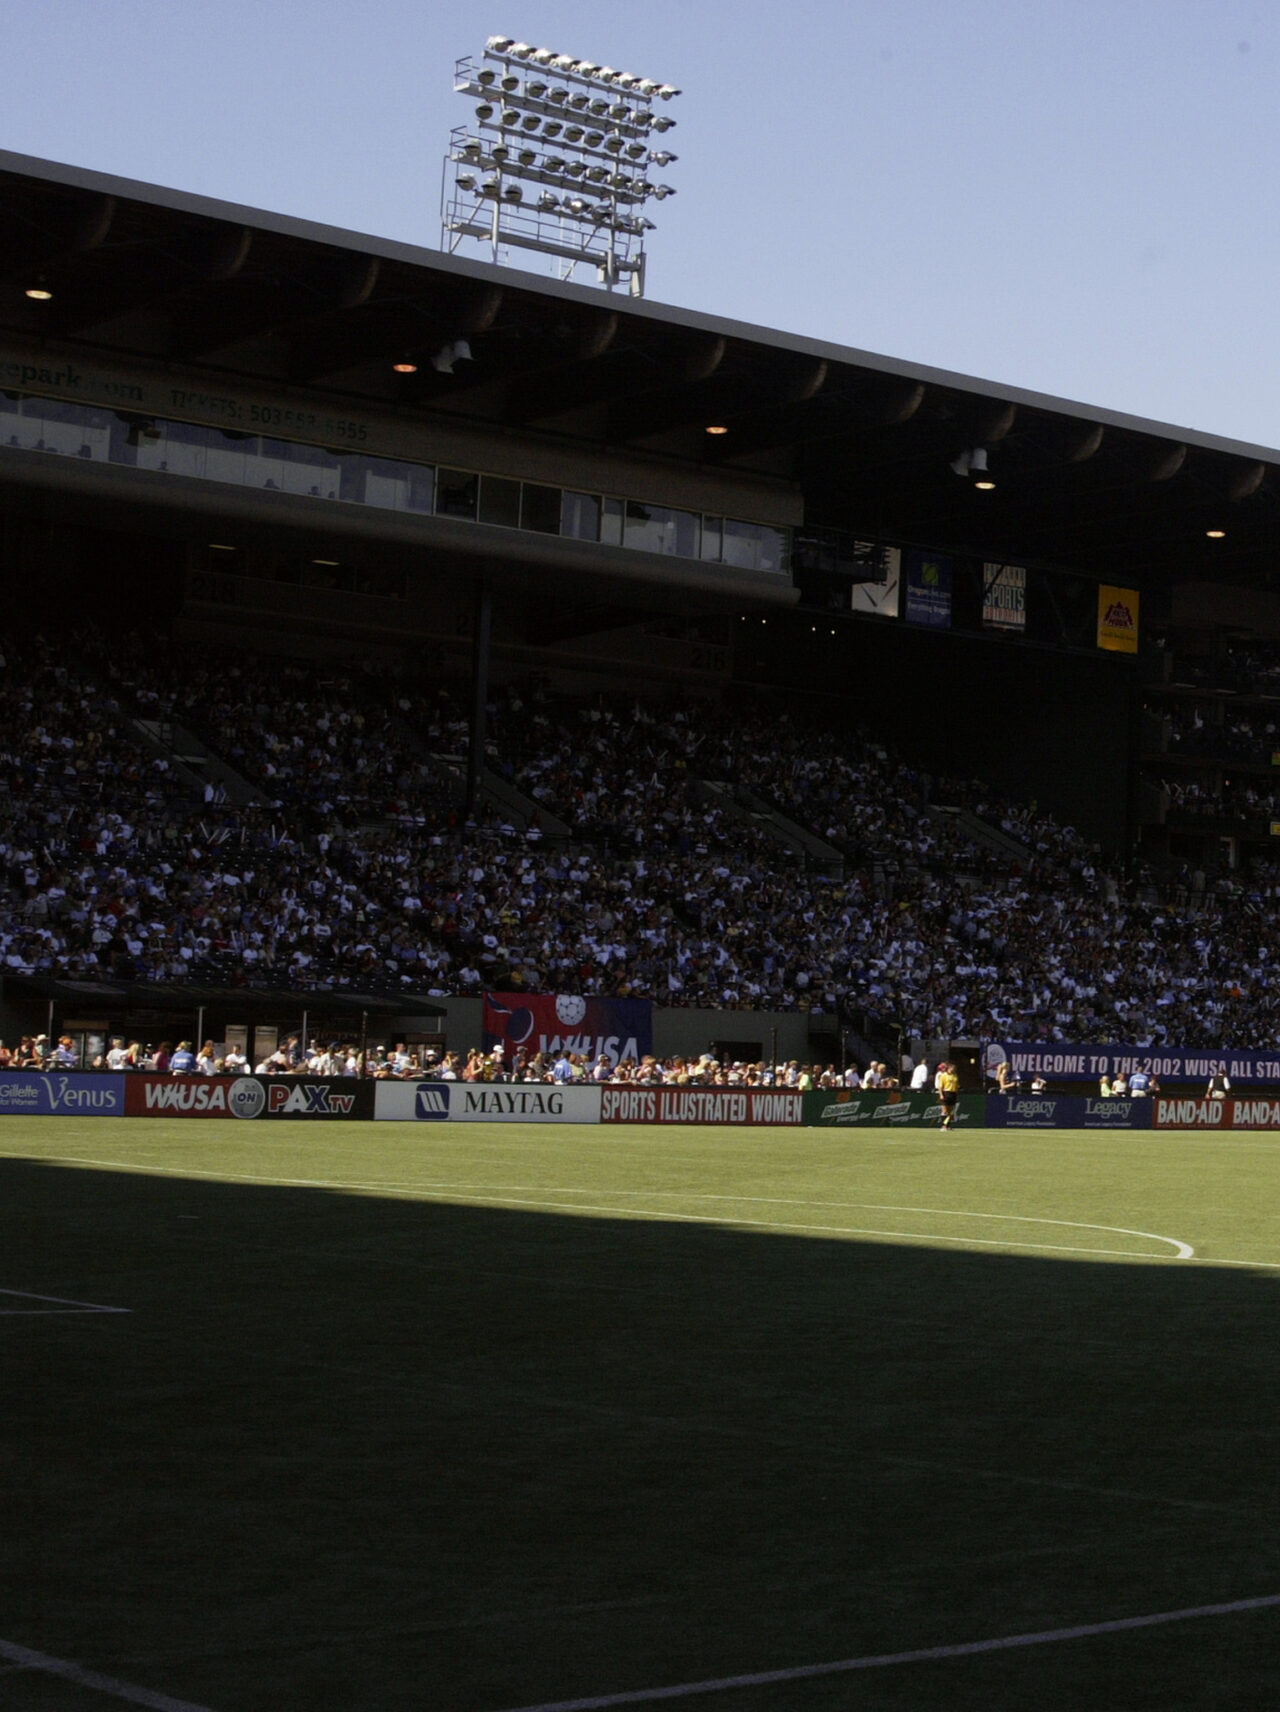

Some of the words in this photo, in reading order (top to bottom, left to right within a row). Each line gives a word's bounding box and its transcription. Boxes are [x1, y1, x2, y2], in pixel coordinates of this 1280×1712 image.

[250, 404, 281, 425] 503
[985, 584, 1025, 610] SPORTS
[1011, 1054, 1086, 1073] WELCOME
[1090, 1056, 1109, 1073] TO
[1113, 1057, 1140, 1074] THE
[1143, 1058, 1181, 1076] 2002
[1184, 1059, 1228, 1078] WUSA
[1230, 1060, 1253, 1079] ALL
[40, 1076, 117, 1110] Venus
[236, 1092, 256, 1103] ON
[267, 1084, 330, 1113] PAX
[329, 1095, 355, 1113] TV
[464, 1091, 563, 1115] MAYTAG
[601, 1091, 656, 1121] SPORTS
[659, 1092, 748, 1122] ILLUSTRATED
[751, 1094, 803, 1123] WOMEN
[1007, 1096, 1057, 1118] Legacy
[1085, 1098, 1132, 1120] Legacy
[1157, 1100, 1222, 1124] BAND-AID
